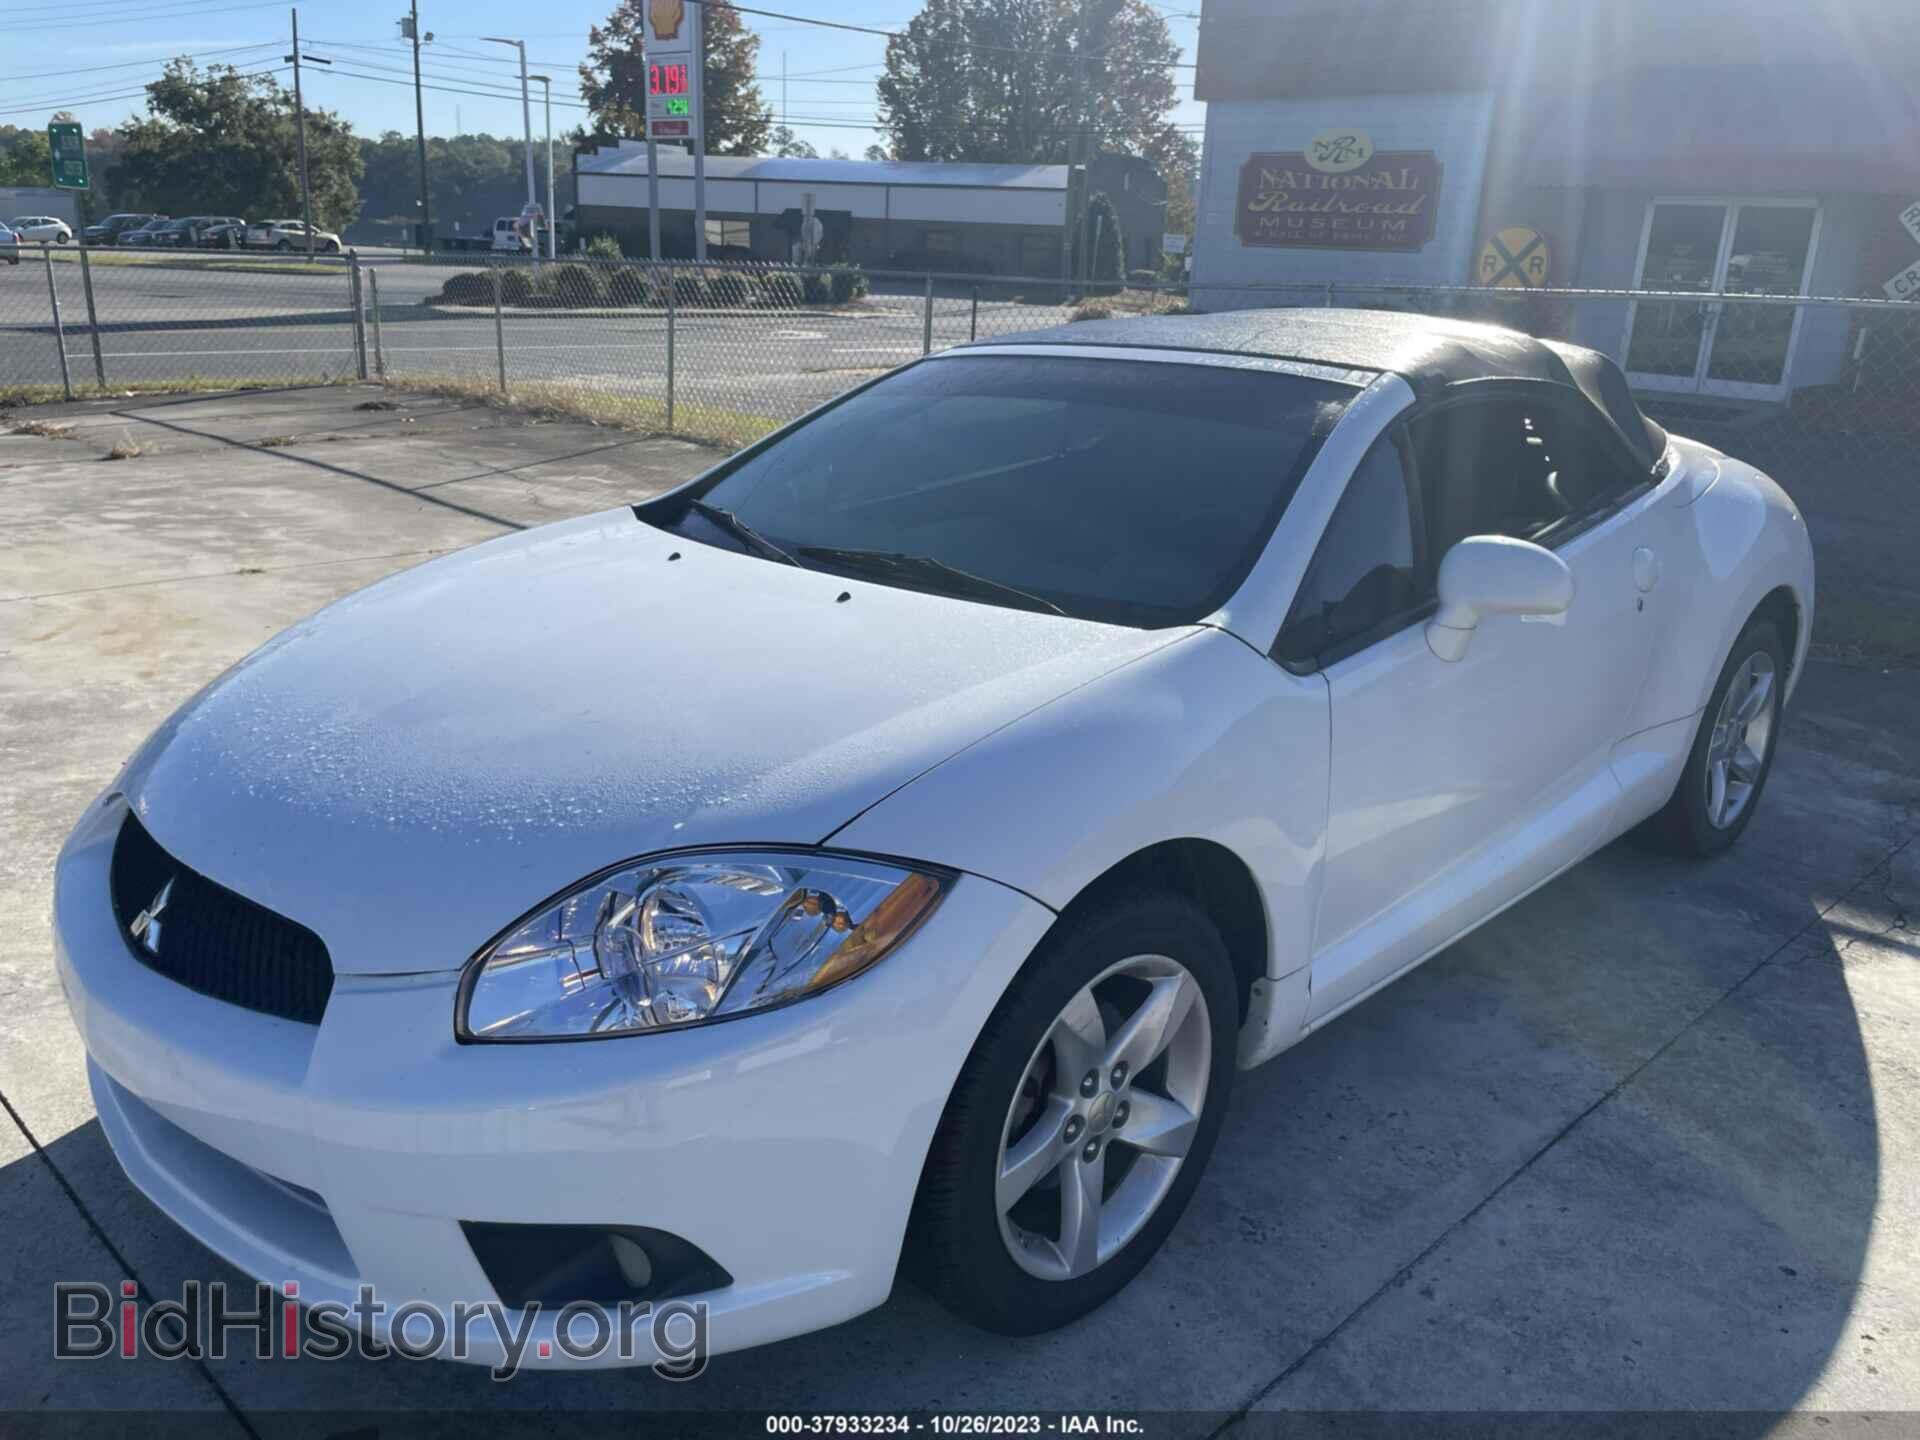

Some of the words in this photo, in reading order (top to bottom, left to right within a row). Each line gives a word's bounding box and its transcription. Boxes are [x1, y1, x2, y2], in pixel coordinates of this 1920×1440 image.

[1258, 168, 1420, 191] NATIONAL
[1248, 190, 1427, 216] Railroad
[1259, 216, 1407, 231] MUSEUM
